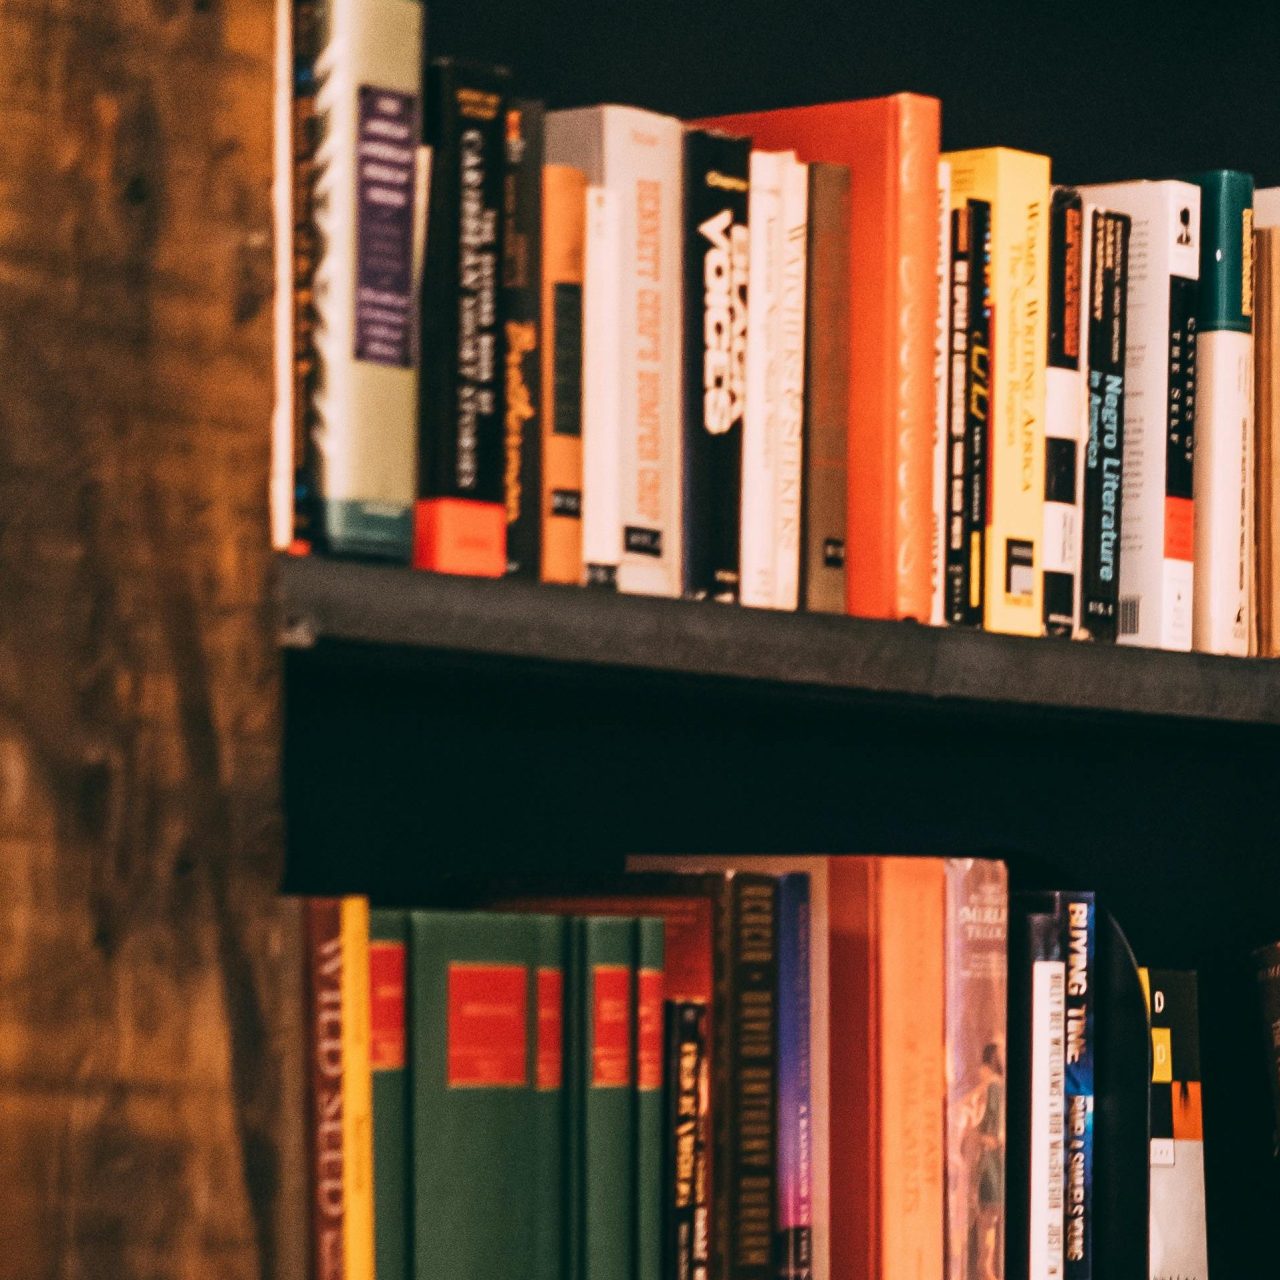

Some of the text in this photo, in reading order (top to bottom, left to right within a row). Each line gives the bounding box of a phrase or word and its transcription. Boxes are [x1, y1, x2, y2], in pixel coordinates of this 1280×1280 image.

[699, 210, 735, 435] VOICES
[1020, 201, 1041, 493] WOMEN WRITING AFRICA
[1169, 330, 1181, 445] THE SELF
[1184, 317, 1196, 463] CENTERS OF
[1087, 371, 1102, 468] in America
[1098, 374, 1123, 582] Negro Literature
[1066, 902, 1088, 1065] BUYING TIME
